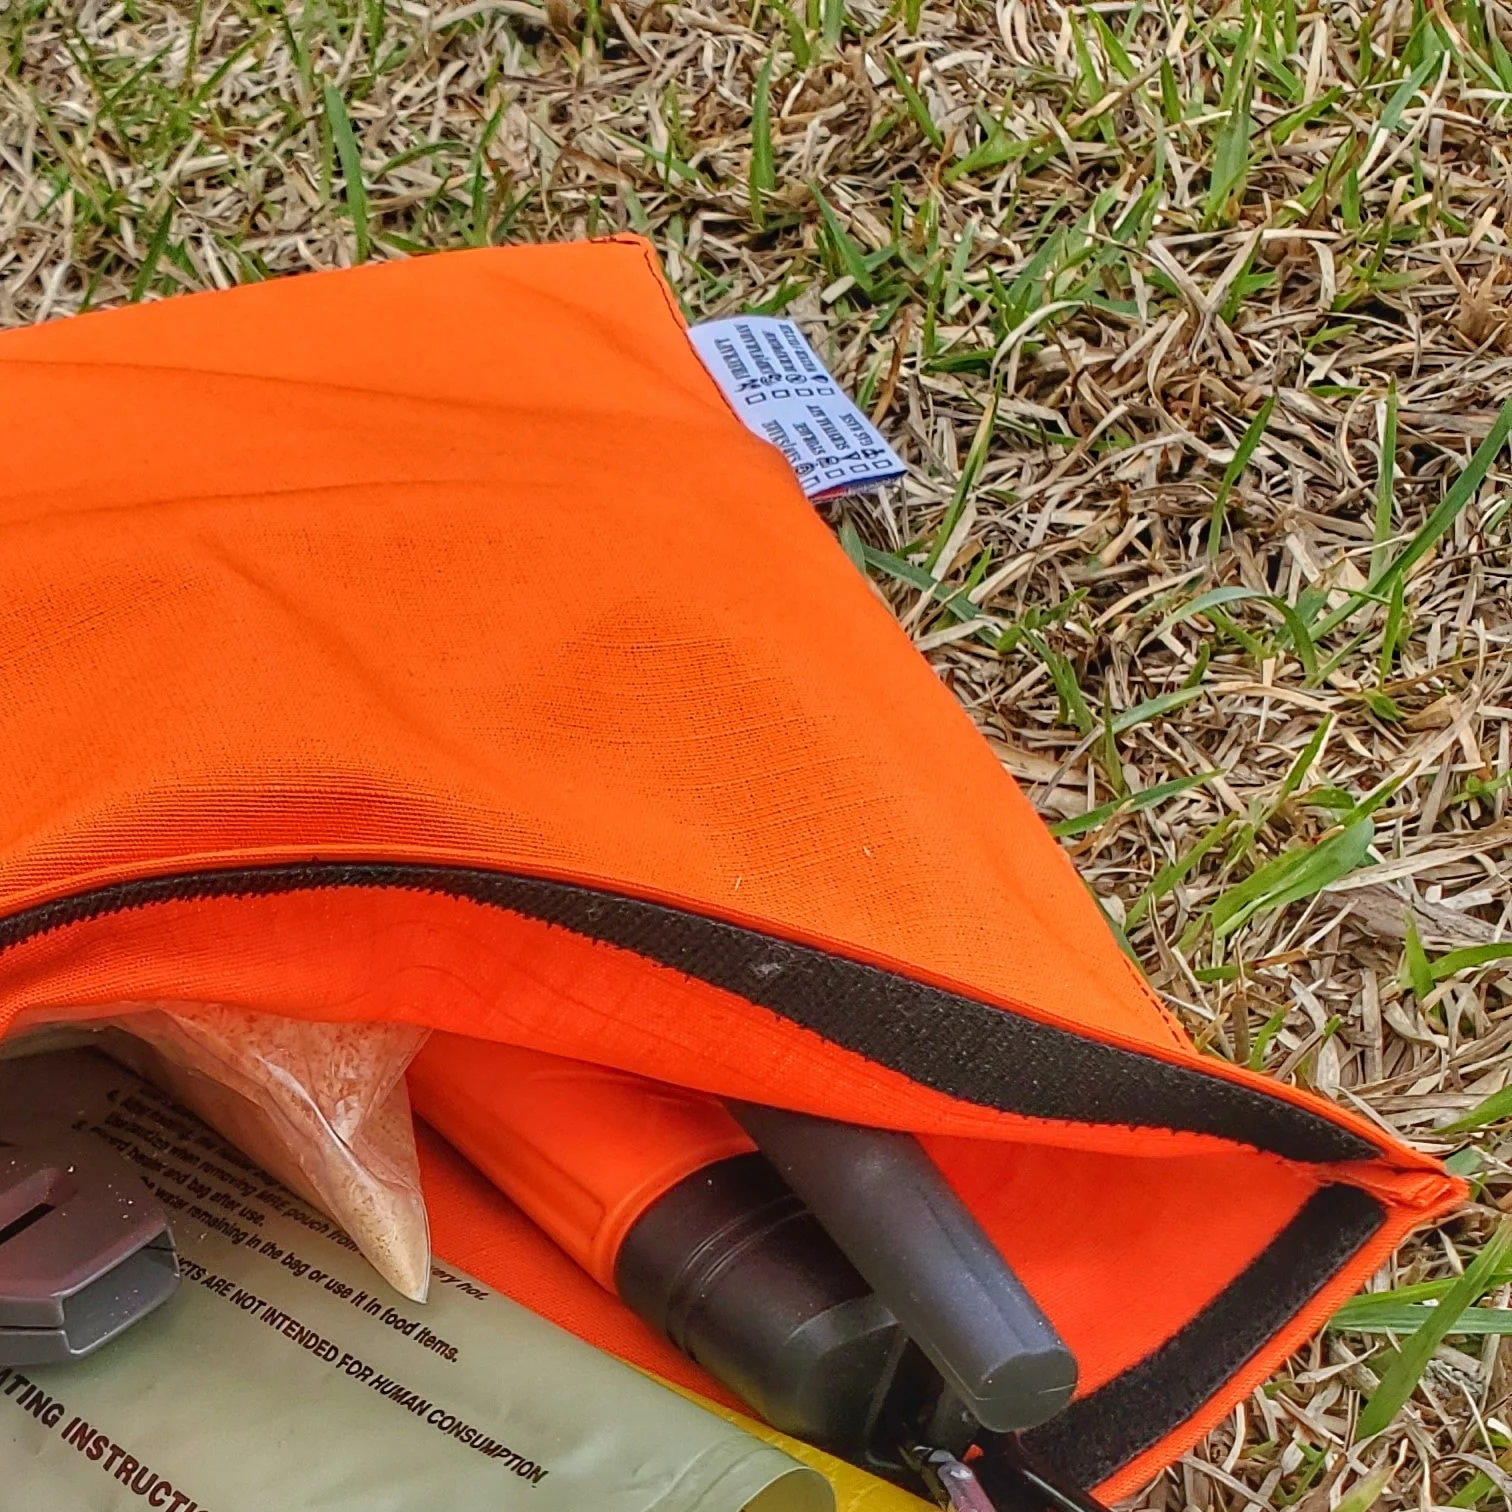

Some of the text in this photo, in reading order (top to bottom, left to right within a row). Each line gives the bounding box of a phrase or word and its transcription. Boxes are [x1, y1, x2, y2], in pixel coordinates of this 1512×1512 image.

[187, 1177, 211, 1199] bag
[209, 1191, 239, 1212] after
[238, 1204, 264, 1228] use.
[199, 1157, 257, 1197] removing
[283, 1206, 329, 1237] pouch
[187, 1204, 250, 1247] remaining
[259, 1237, 283, 1260] the
[281, 1251, 310, 1277] bag
[309, 1267, 326, 1285] or
[325, 1278, 352, 1299] use
[380, 1306, 419, 1337] food
[415, 1325, 458, 1362] items.
[201, 1275, 236, 1298] ARE
[230, 1289, 268, 1316] NOT
[260, 1305, 338, 1362] INTENDED
[336, 1353, 373, 1382] FOR
[369, 1374, 432, 1418] HUMAN
[427, 1409, 548, 1485] CONSUMPTION
